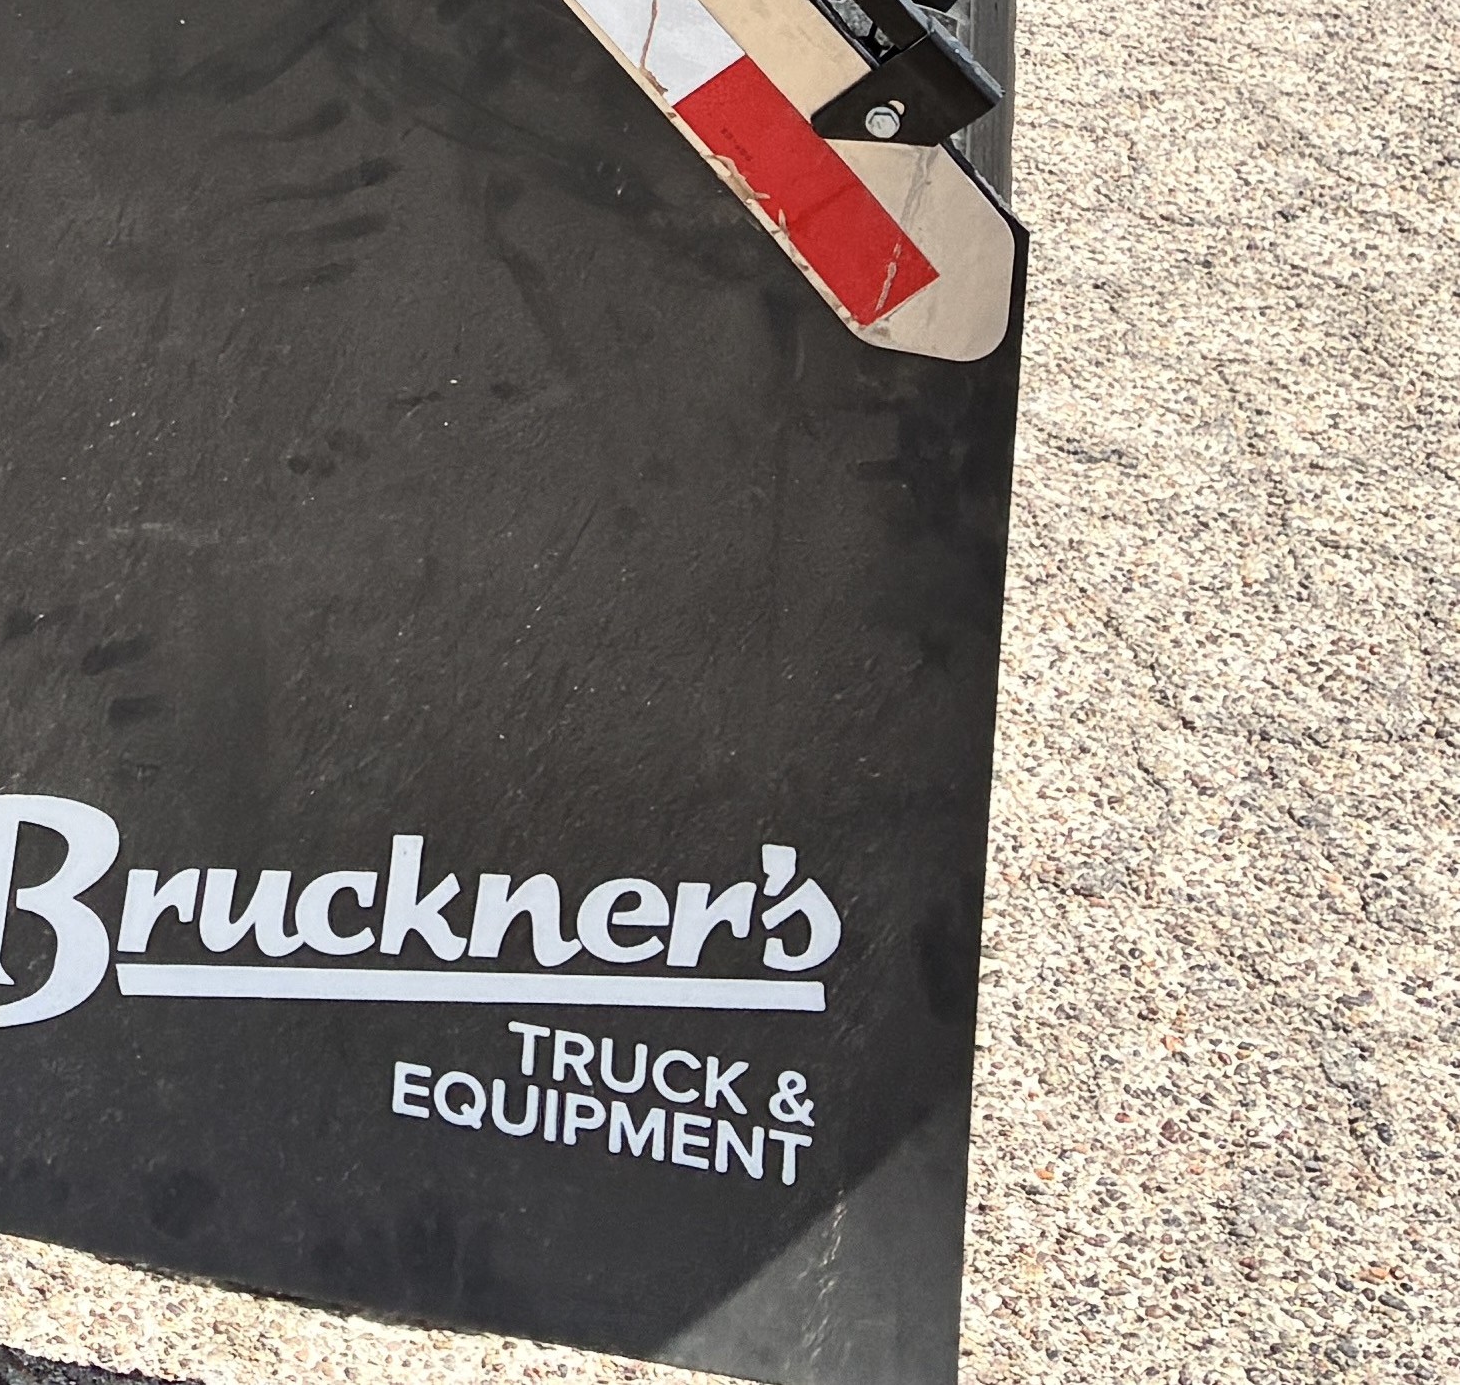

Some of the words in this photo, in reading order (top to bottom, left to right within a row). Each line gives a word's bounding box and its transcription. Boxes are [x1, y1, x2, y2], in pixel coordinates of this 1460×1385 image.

[392, 1061, 814, 1187] EQUIPMENT
[508, 1020, 750, 1116] TRUCK
[768, 1070, 816, 1128] &
